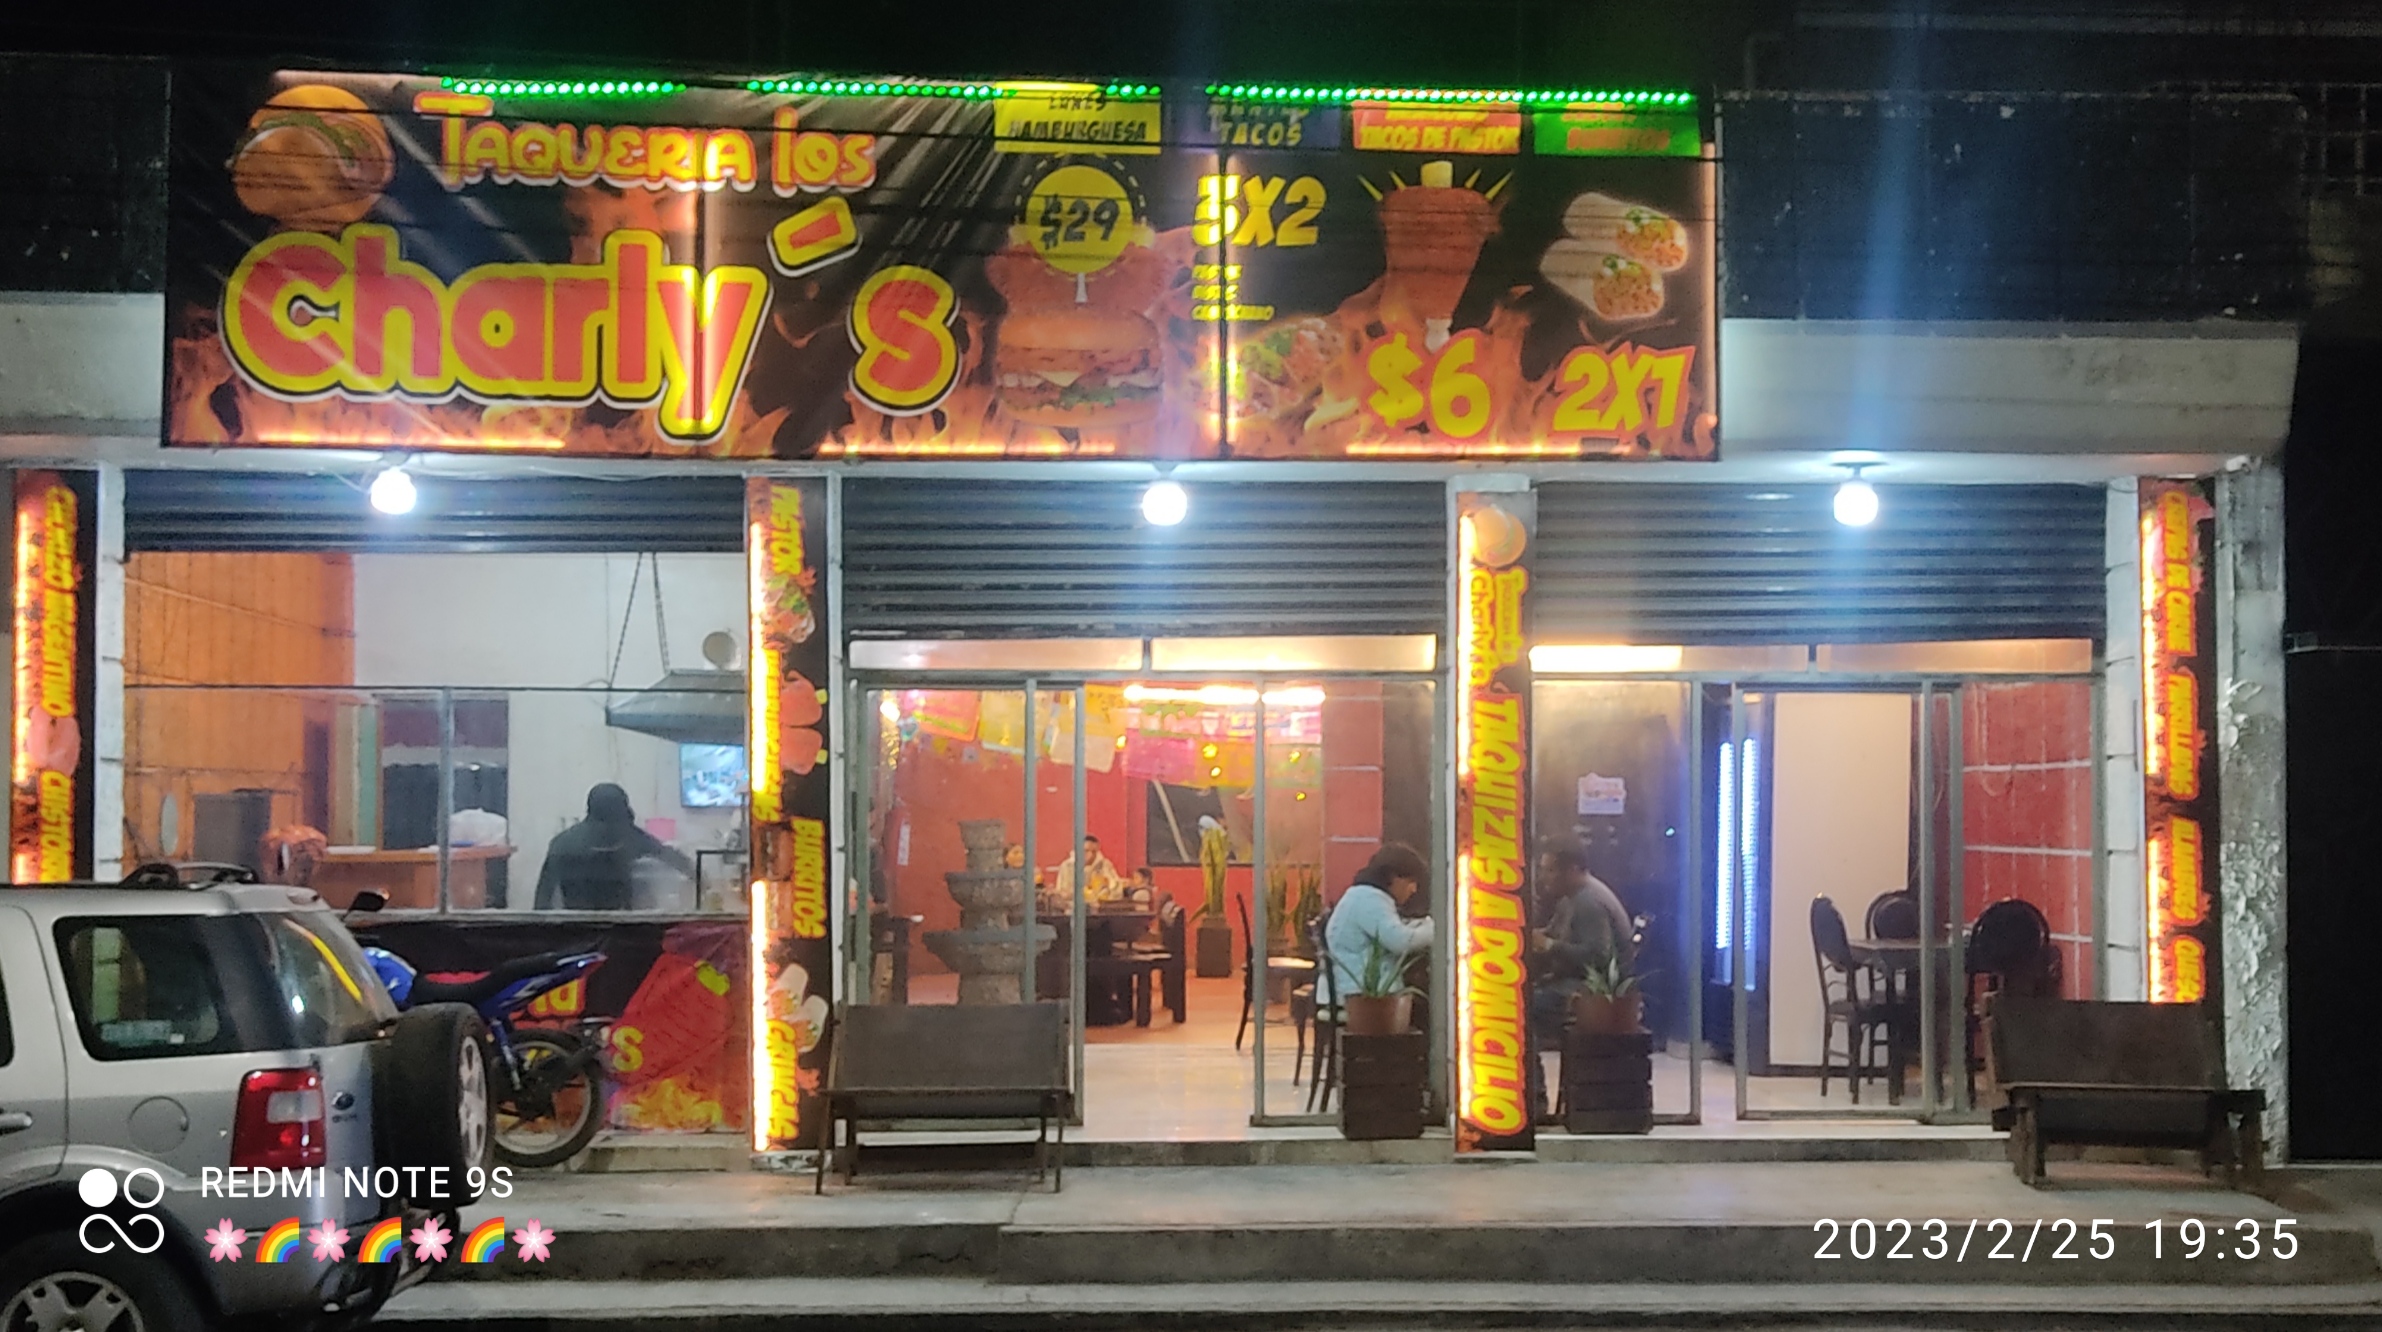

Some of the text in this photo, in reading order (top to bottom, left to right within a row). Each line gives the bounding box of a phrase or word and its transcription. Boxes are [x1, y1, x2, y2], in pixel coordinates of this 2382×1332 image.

[1009, 120, 1147, 142] HAMBURGUESA
[1219, 121, 1302, 146] TACOS
[1040, 194, 1119, 250] $29
[1192, 174, 1327, 247] 5X2
[1368, 331, 1491, 438] $6
[1553, 352, 1687, 431] 2X1
[770, 485, 803, 576] PASTOR
[792, 819, 826, 938] BURRITOS
[1471, 698, 1519, 1129] TAQUIZAS A DOMICILIO
[760, 1020, 798, 1138] GRINGAS
